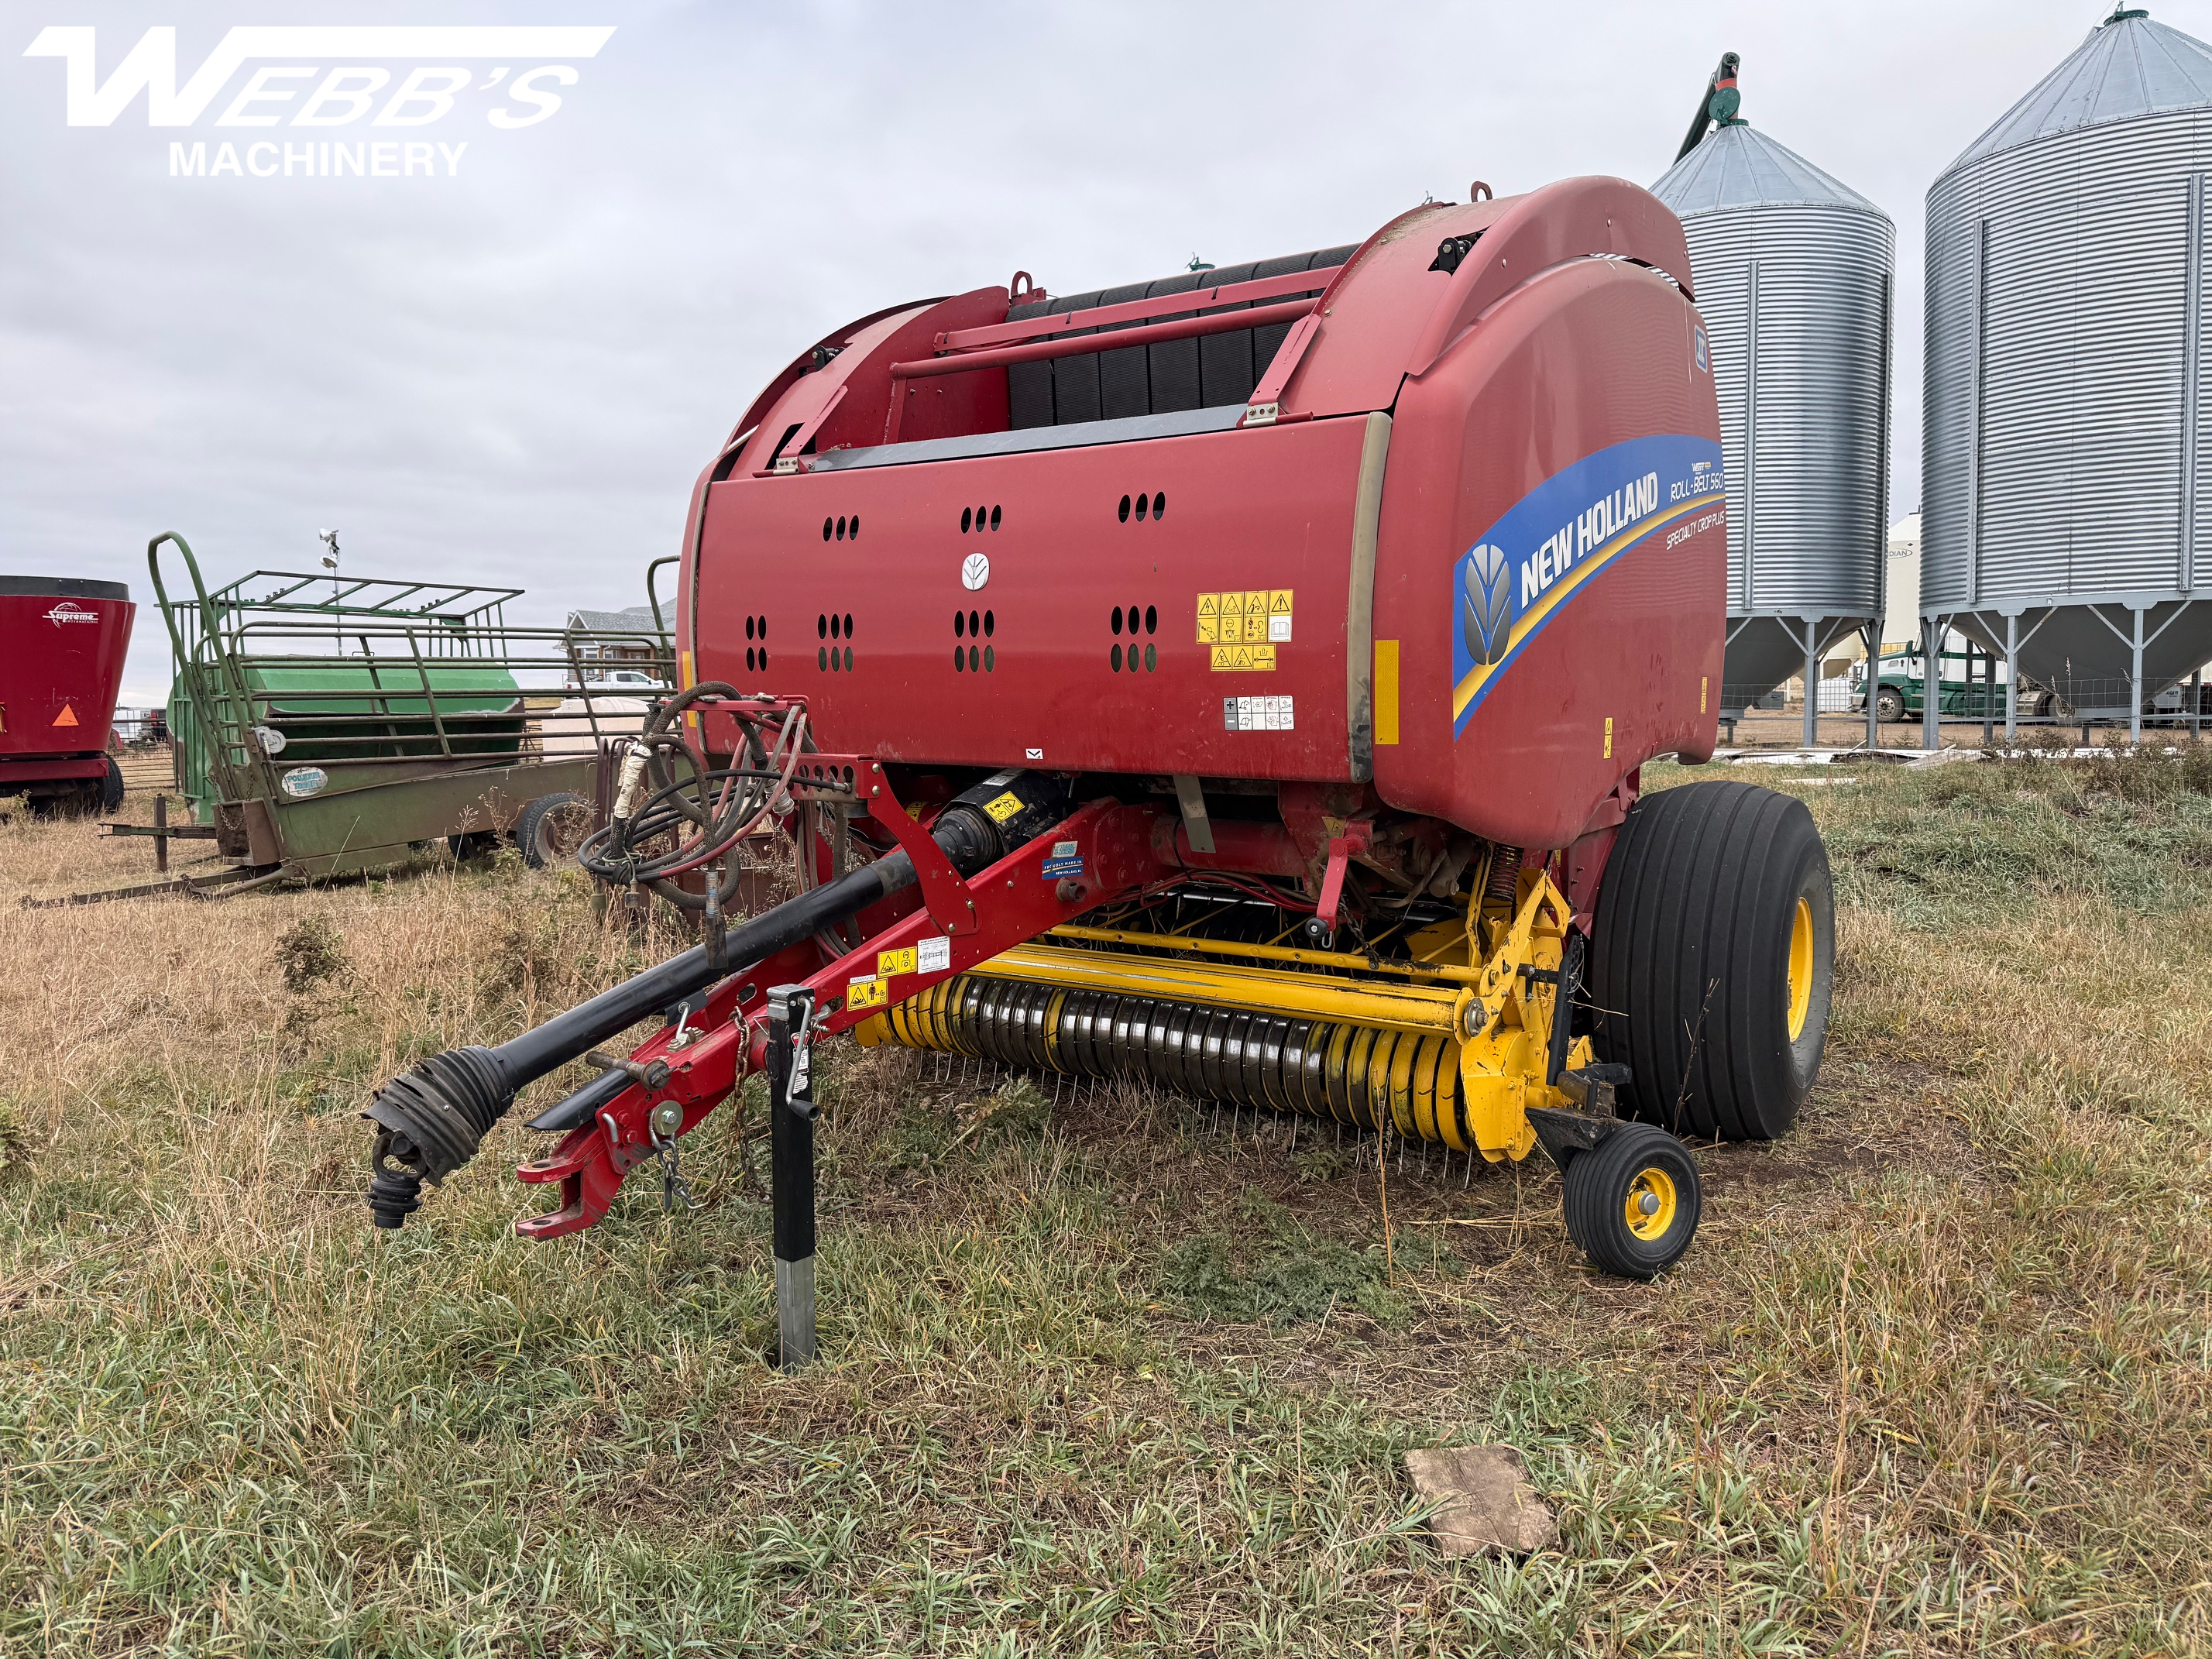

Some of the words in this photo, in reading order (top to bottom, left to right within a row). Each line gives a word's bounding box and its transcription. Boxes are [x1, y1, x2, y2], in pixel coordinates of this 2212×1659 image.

[1710, 472, 1724, 490] 560
[1521, 522, 1574, 610] NEW
[1578, 472, 1658, 558] HOLLAND
[1666, 520, 1698, 551] SPECIALTY
[1698, 514, 1712, 533] CROP
[1712, 510, 1725, 527] PLUS
[42, 610, 99, 623] Supreme
